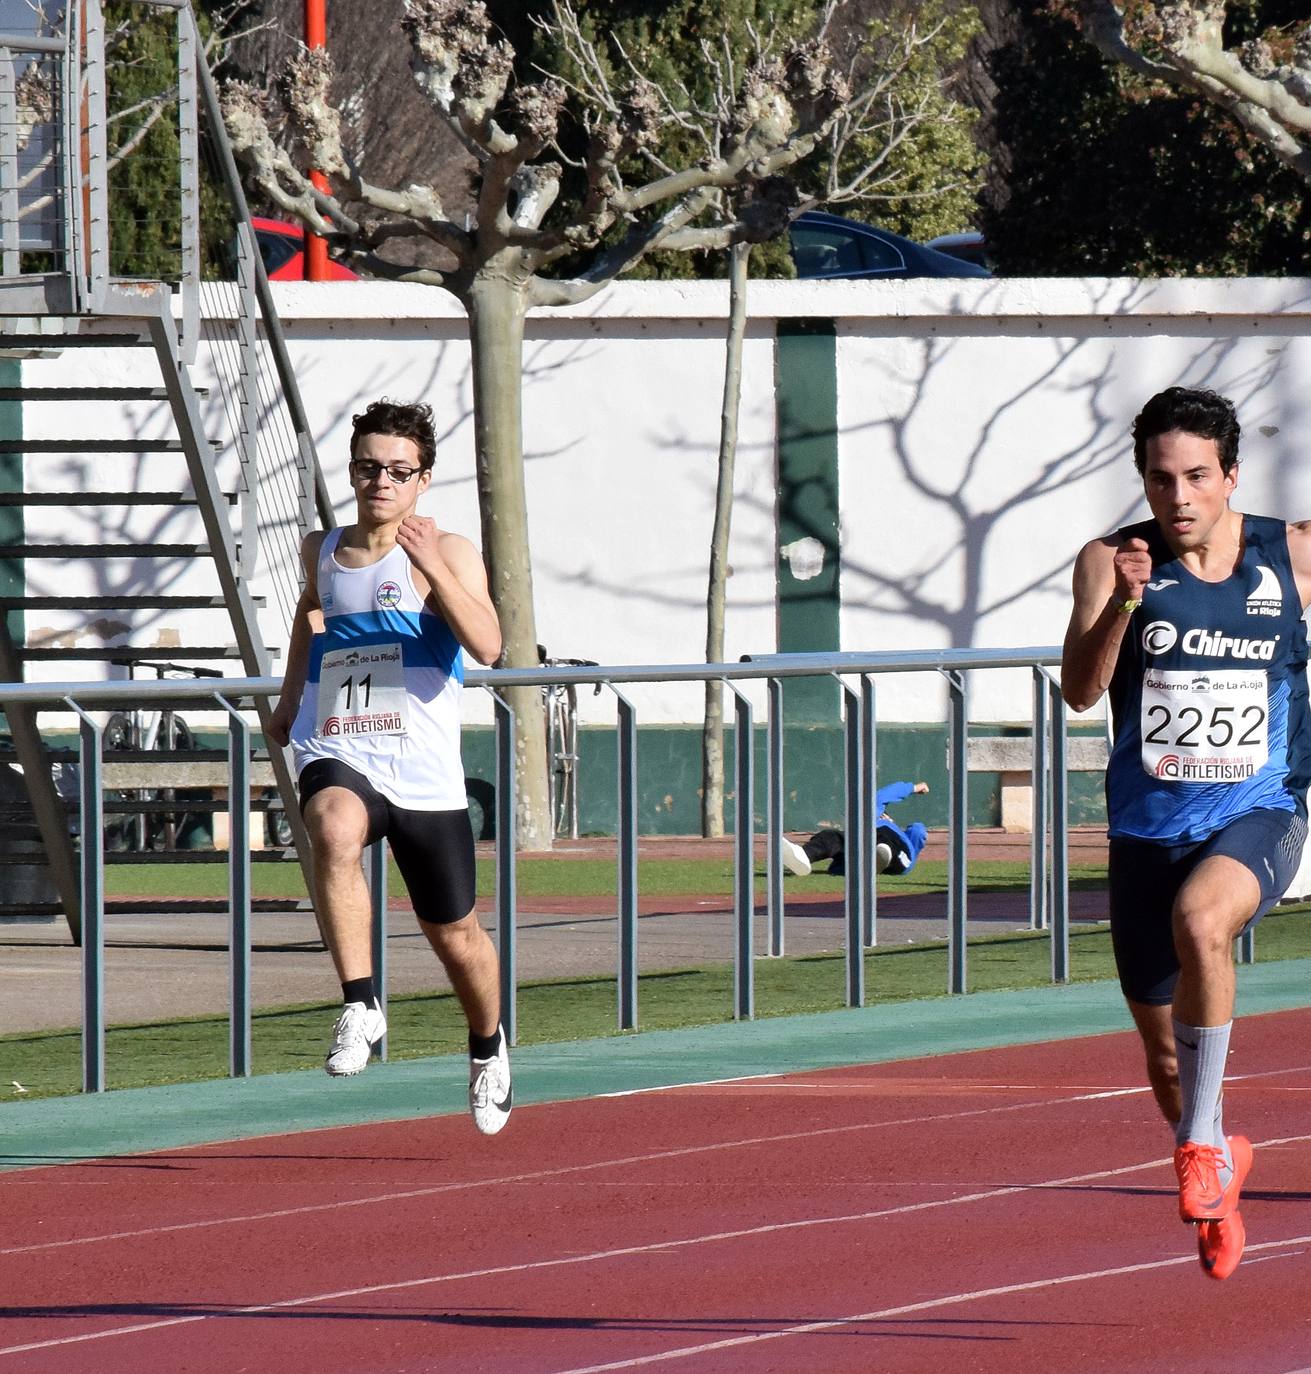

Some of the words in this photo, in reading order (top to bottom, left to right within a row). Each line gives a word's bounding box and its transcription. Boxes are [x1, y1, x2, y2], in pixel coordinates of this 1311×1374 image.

[1247, 607, 1258, 615] La
[1260, 607, 1281, 617] Rioja
[1182, 629, 1276, 660] Chiruca
[371, 654, 380, 662] La
[341, 673, 371, 709] 11
[1146, 679, 1189, 691] Gobierno
[1212, 682, 1225, 691] de
[1226, 681, 1238, 690] La
[343, 718, 401, 734] ATLETISMO
[1144, 705, 1266, 748] 2252
[1182, 763, 1254, 779] ATLETISMO
